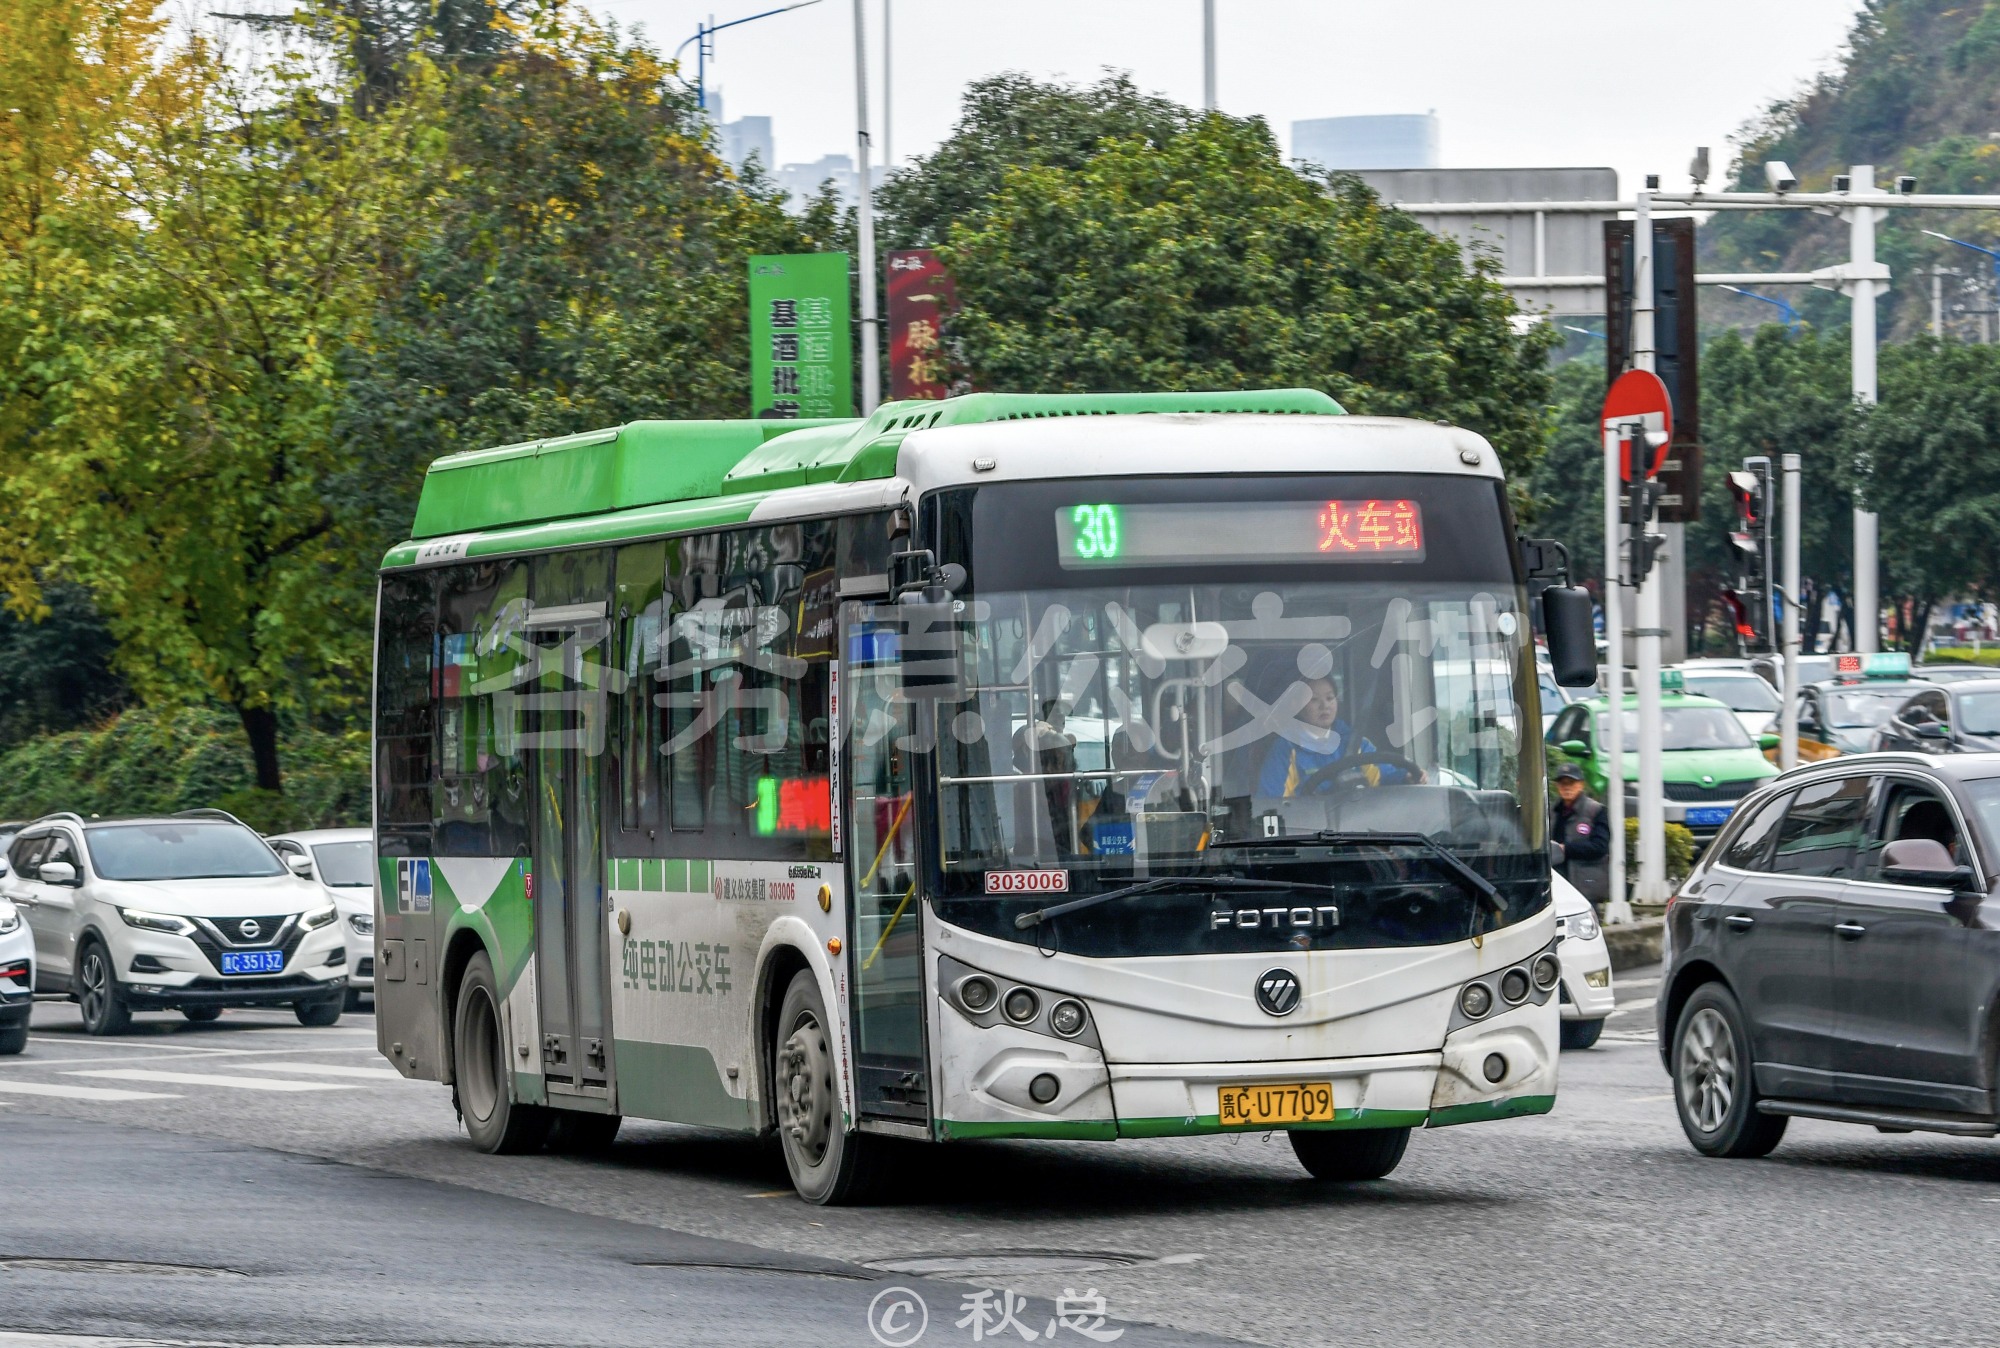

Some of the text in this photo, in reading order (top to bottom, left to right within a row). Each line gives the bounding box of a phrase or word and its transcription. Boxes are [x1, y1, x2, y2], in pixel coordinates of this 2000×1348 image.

[1074, 504, 1118, 559] 30
[723, 878, 795, 901] 遵义公交集团 303006
[987, 872, 1065, 892] 303006
[1209, 905, 1340, 931] FOTON
[622, 937, 732, 996] 纯电动公交车
